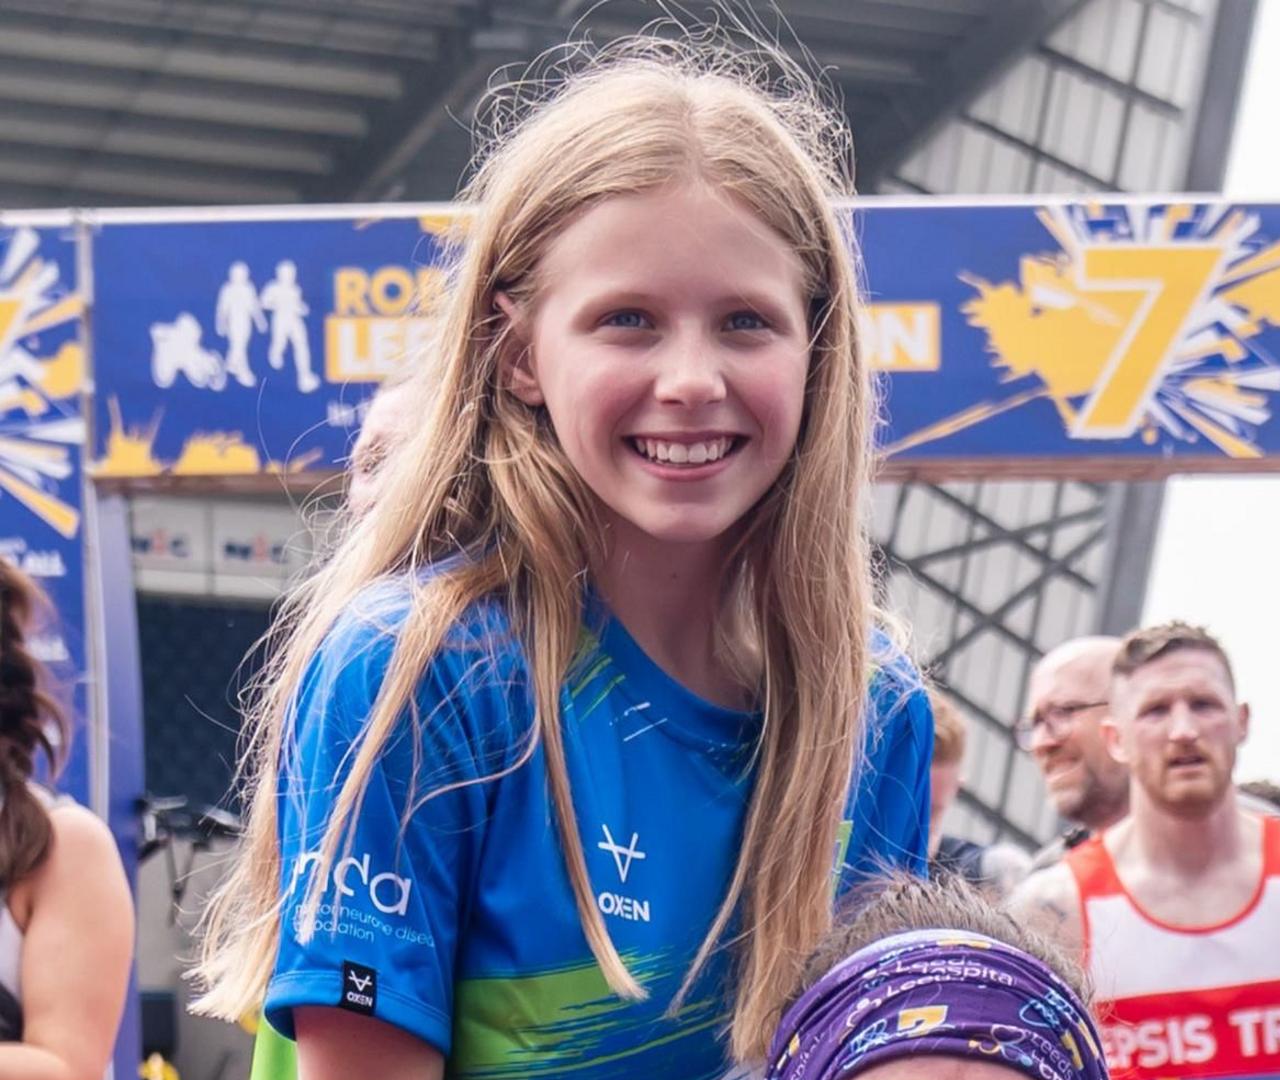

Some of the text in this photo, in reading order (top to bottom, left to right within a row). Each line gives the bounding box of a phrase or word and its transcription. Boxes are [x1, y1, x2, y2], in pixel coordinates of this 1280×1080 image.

[1074, 244, 1229, 439] 7
[291, 852, 412, 916] nda
[599, 892, 651, 922] OXEN
[395, 924, 435, 948] disea
[346, 990, 373, 1007] OXEN
[1101, 1013, 1218, 1069] EPSIS
